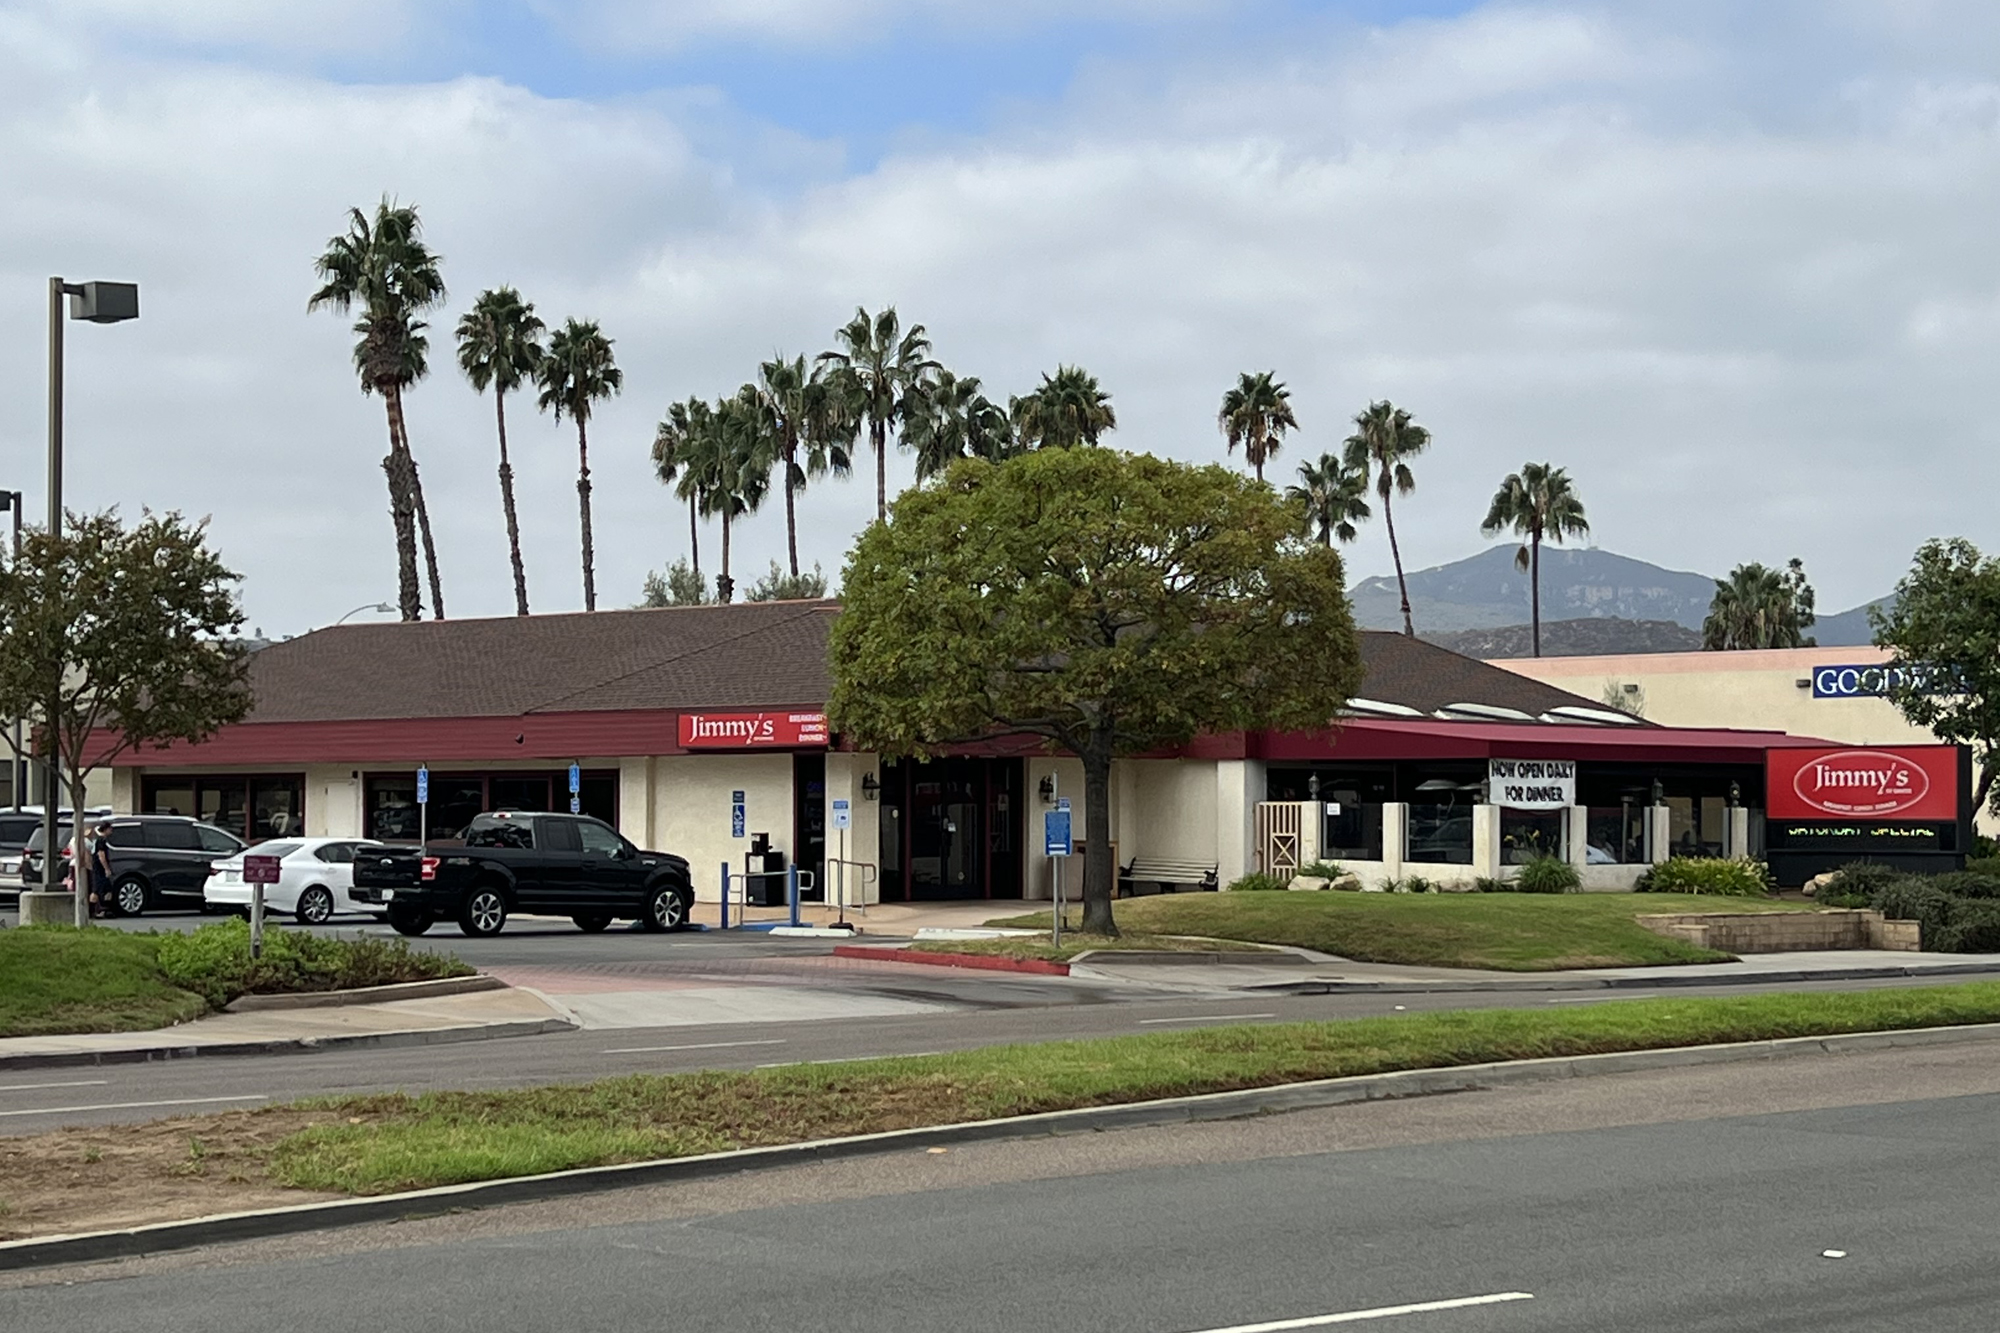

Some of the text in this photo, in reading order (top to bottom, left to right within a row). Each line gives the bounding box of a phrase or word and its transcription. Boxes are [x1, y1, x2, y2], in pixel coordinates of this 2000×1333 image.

[689, 713, 774, 744] Jimmy's
[1491, 762, 1574, 778] NOW OPEN DAILY
[1813, 762, 1909, 795] Jimmy's
[1504, 785, 1564, 802] FOR DINNER
